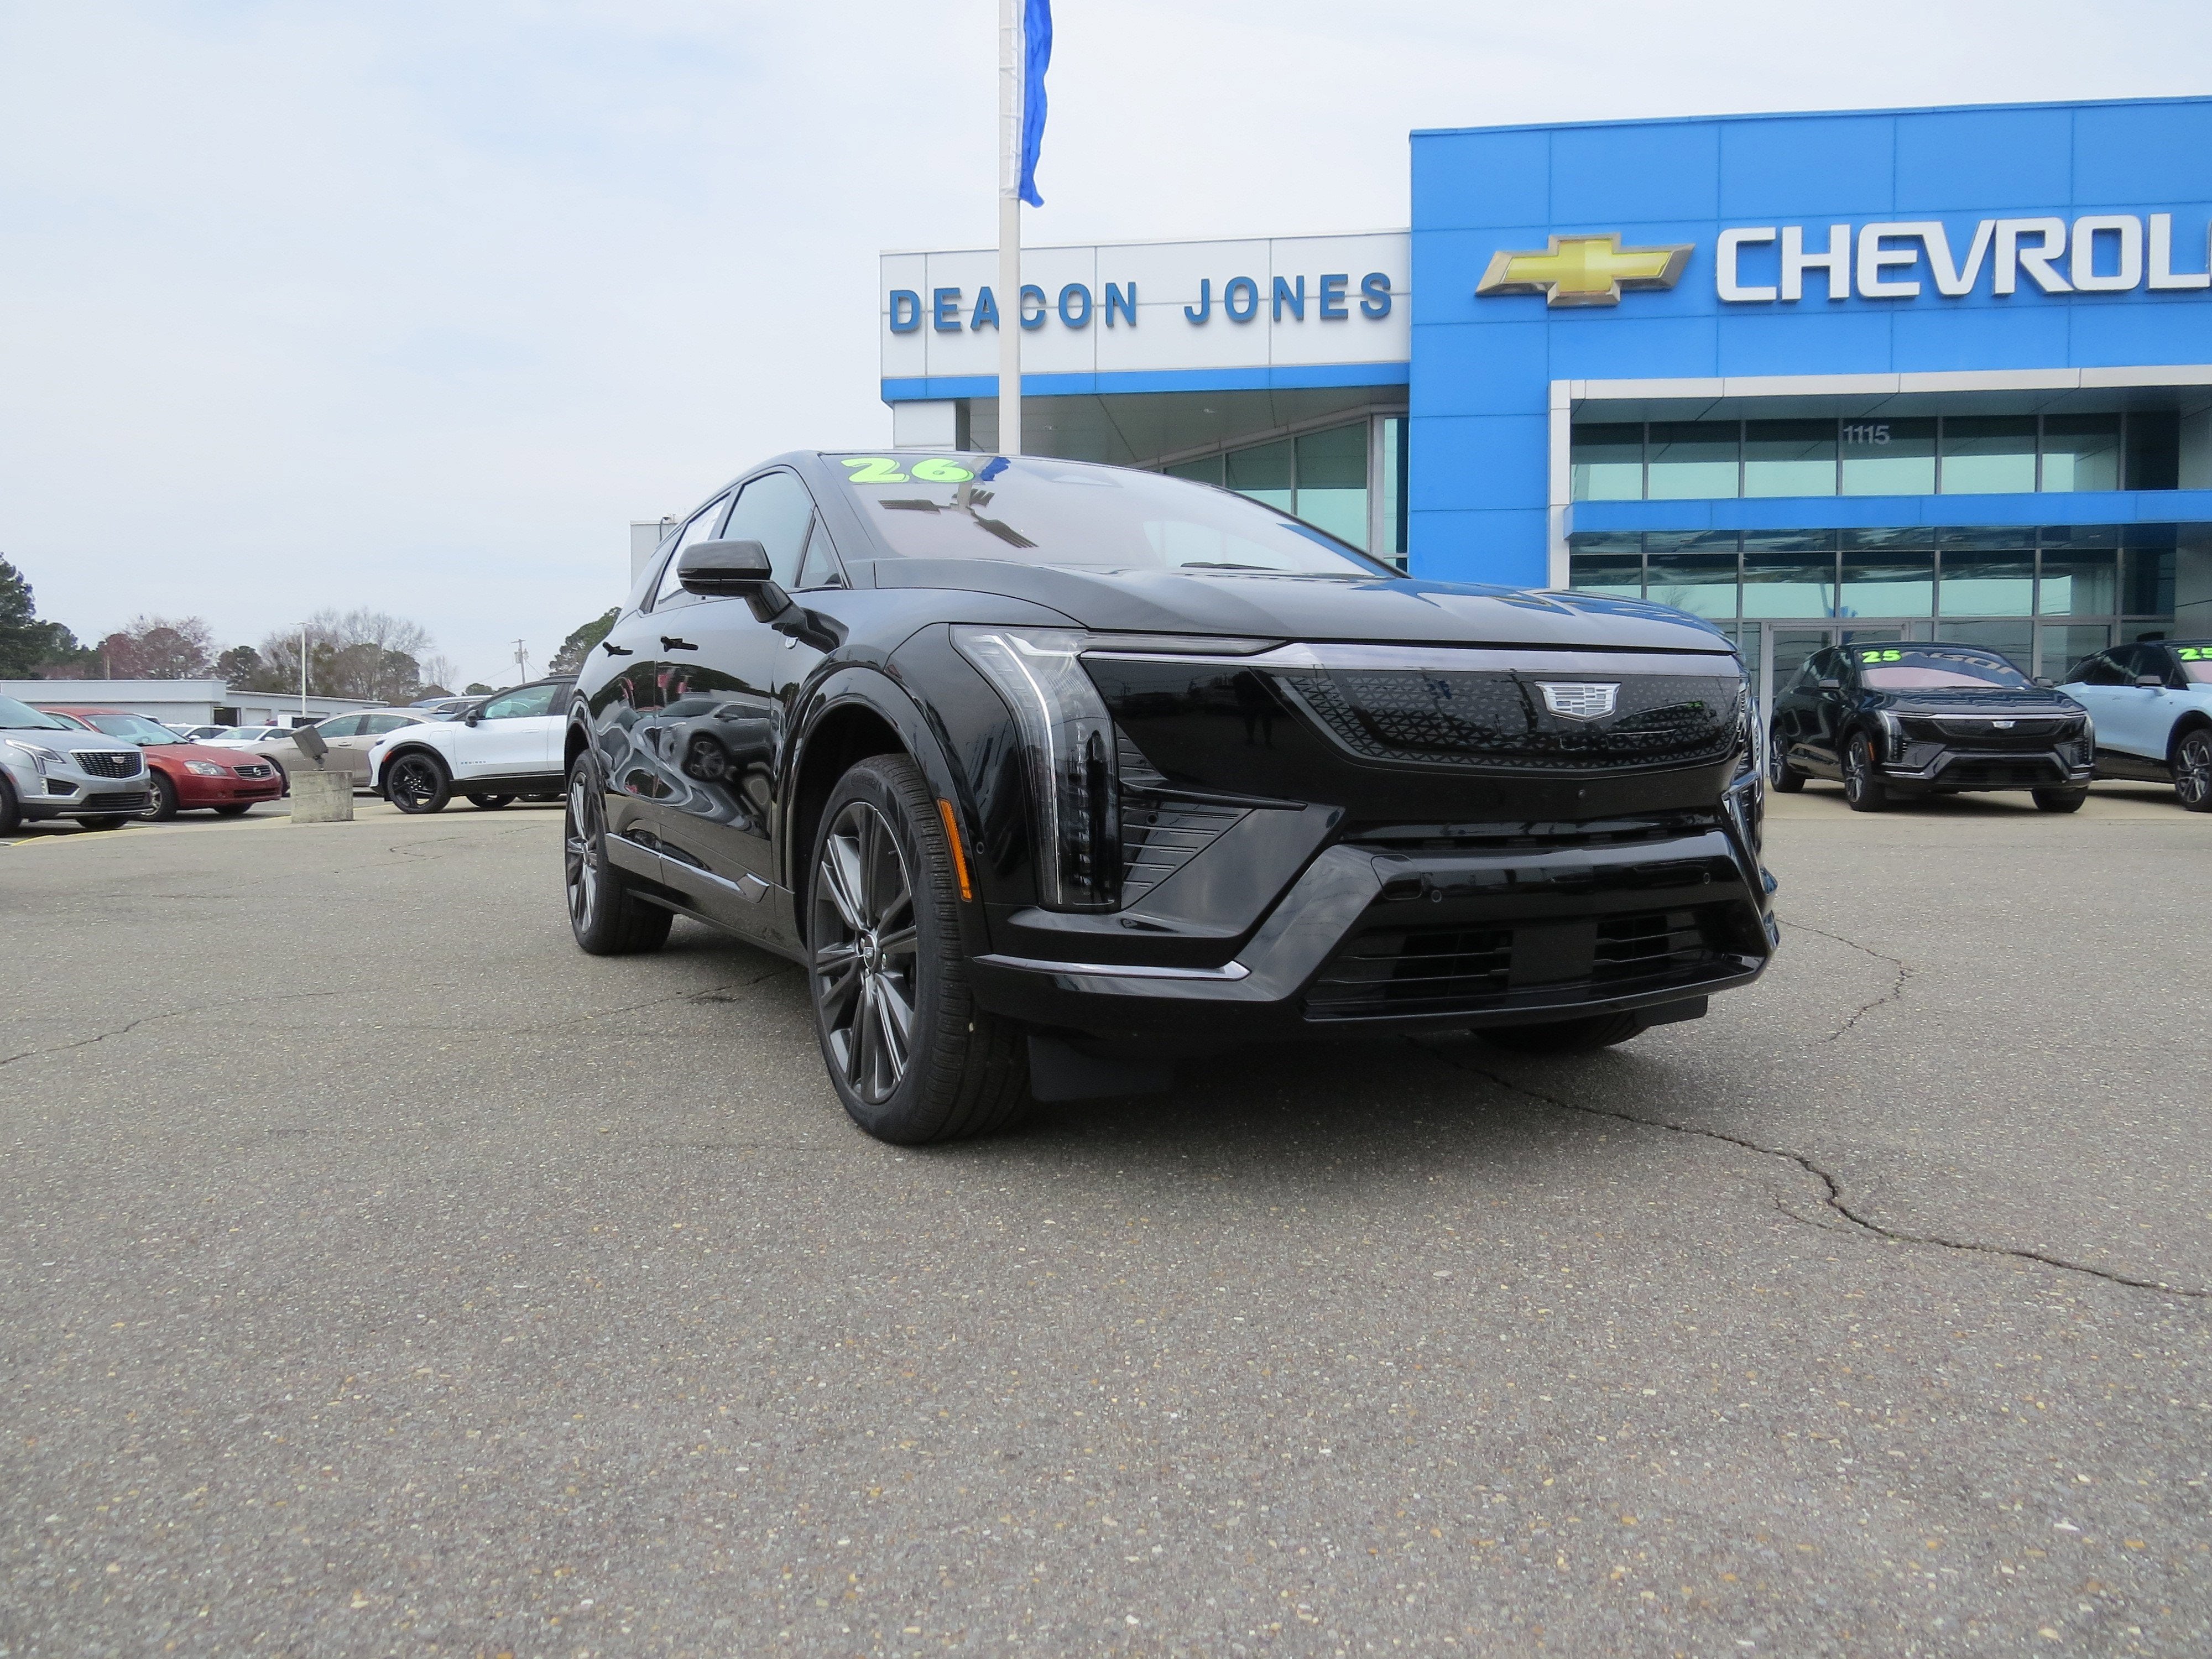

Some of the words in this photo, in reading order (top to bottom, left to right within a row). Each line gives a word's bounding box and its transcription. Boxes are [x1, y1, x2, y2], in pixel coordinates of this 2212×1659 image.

[1717, 212, 2212, 301] CHEVROL
[889, 282, 1136, 333] DEACON
[1184, 272, 1392, 325] JONES
[1843, 425, 1890, 445] 1115
[841, 457, 974, 484] 26
[1861, 649, 1902, 663] 25
